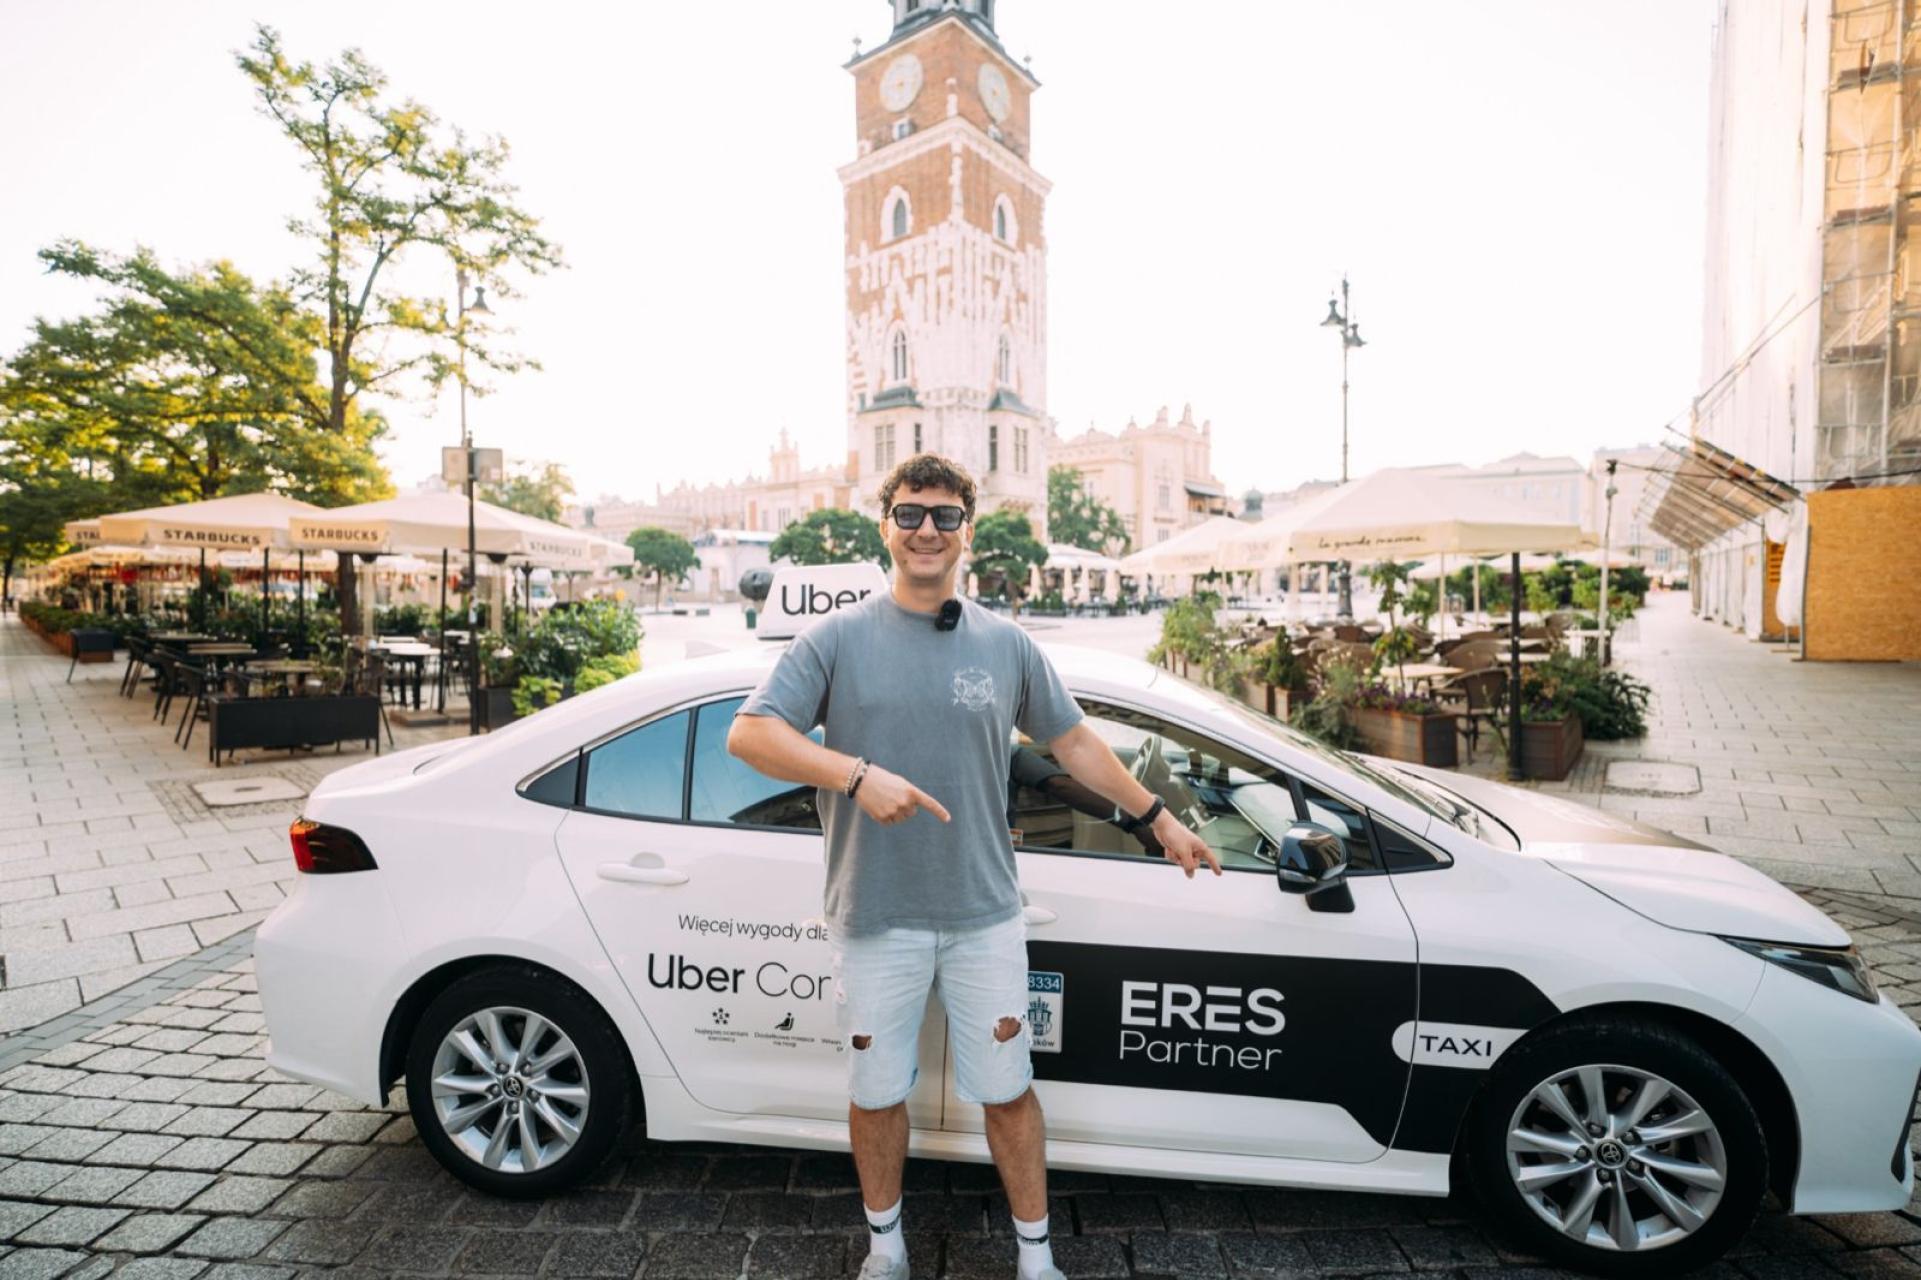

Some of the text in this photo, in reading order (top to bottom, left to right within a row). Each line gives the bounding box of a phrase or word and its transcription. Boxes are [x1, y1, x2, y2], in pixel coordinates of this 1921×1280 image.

[163, 529, 261, 545] STARBUCKS
[301, 527, 379, 542] STARBUCKS
[781, 584, 871, 616] Uber
[678, 914, 733, 936] Więcej
[737, 922, 803, 942] wygody
[647, 953, 745, 994] Uber
[1120, 980, 1286, 1036] ERES
[1119, 1029, 1283, 1071] Partner
[1419, 1035, 1492, 1057] TAXI
